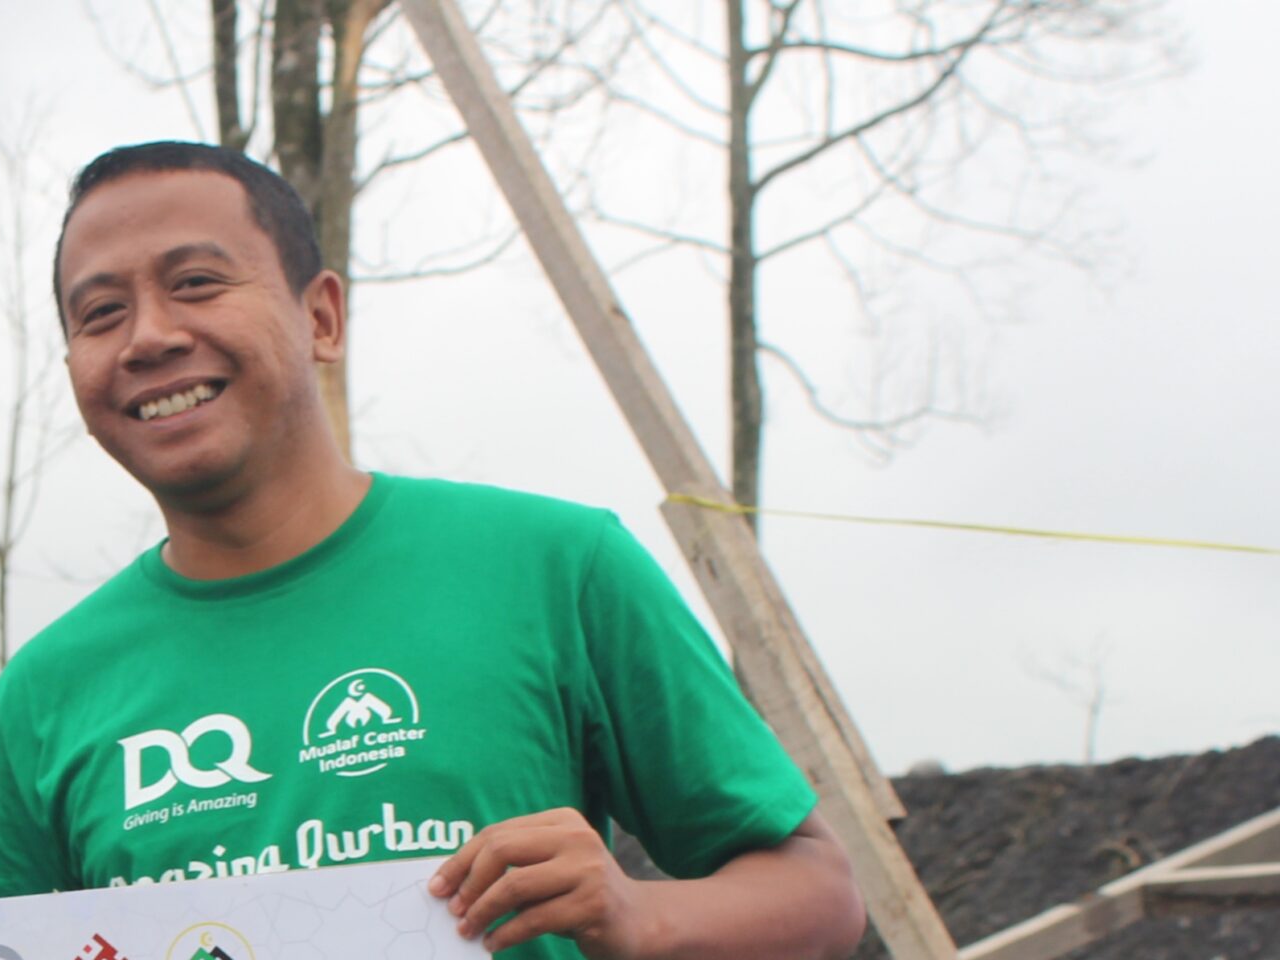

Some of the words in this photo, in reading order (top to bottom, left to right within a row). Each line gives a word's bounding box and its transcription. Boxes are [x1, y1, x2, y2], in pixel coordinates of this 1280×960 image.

[117, 713, 274, 811] DQ
[299, 735, 360, 763] Mualaf
[363, 728, 427, 748] Center
[319, 745, 406, 773] Indonesia
[123, 807, 169, 831] Giving
[172, 803, 185, 818] is
[187, 792, 258, 815] Amazing
[296, 803, 475, 868] Qurban
